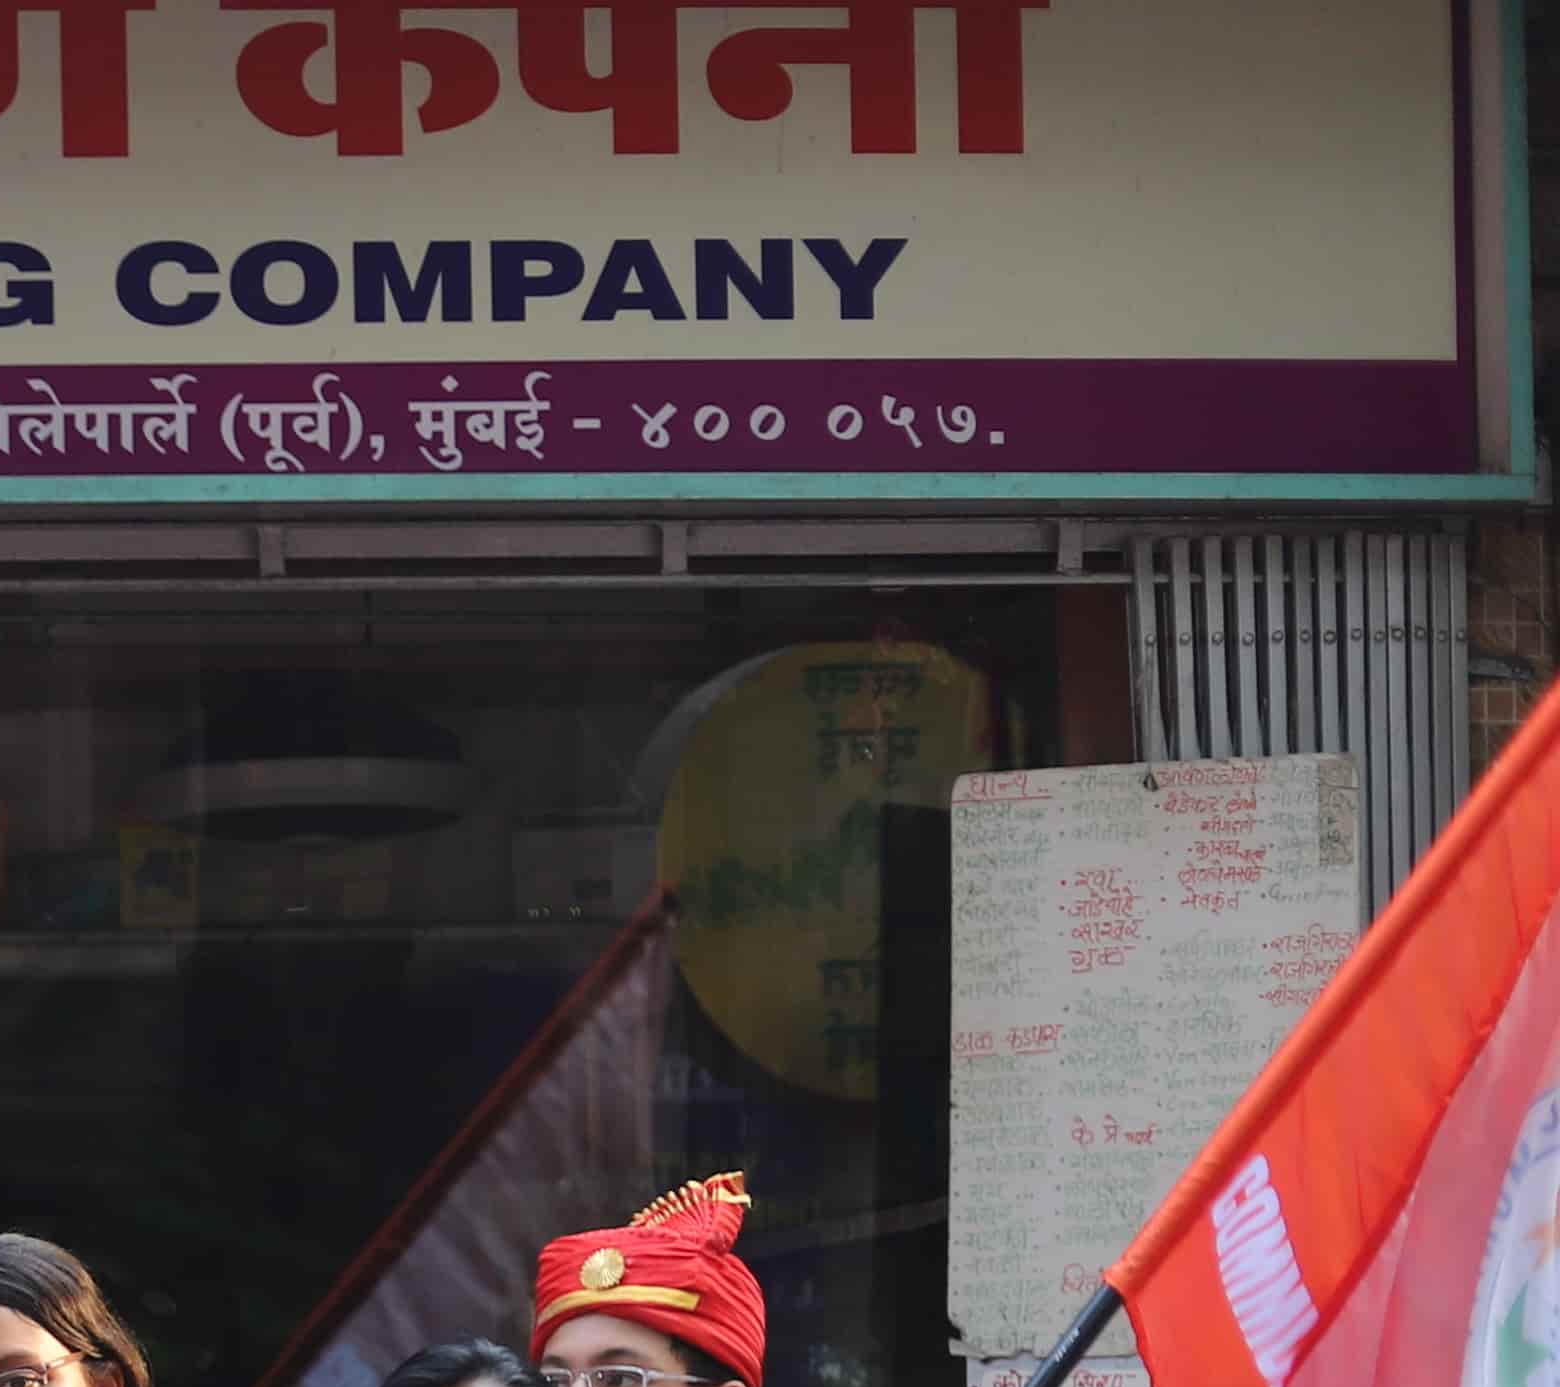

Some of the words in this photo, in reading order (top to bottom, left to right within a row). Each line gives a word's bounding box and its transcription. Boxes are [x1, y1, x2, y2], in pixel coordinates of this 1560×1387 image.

[115, 237, 909, 327] COMPANY
[407, 375, 552, 471] मुंबई
[631, 402, 786, 449] ४००
